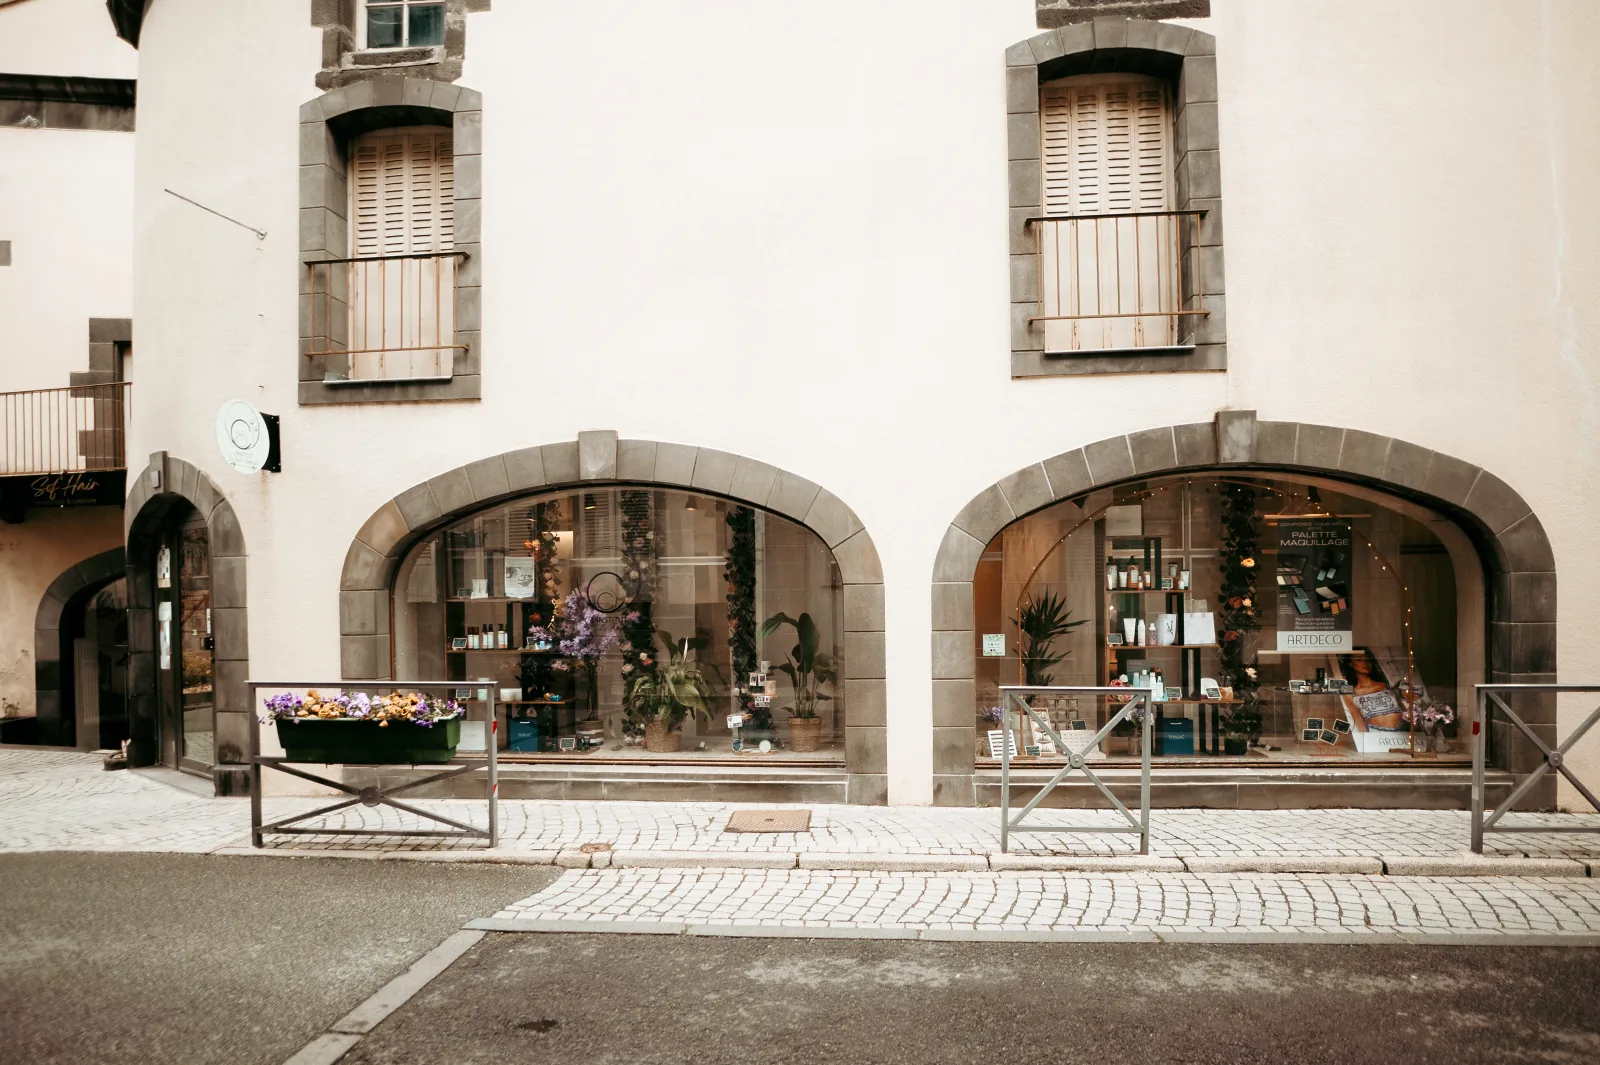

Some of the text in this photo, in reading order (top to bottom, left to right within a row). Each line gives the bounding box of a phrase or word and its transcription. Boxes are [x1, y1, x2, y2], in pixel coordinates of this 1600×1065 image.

[62, 474, 100, 497] Hair
[1287, 634, 1342, 645] ARTDECO
[1378, 737, 1424, 746] ARTDEO
